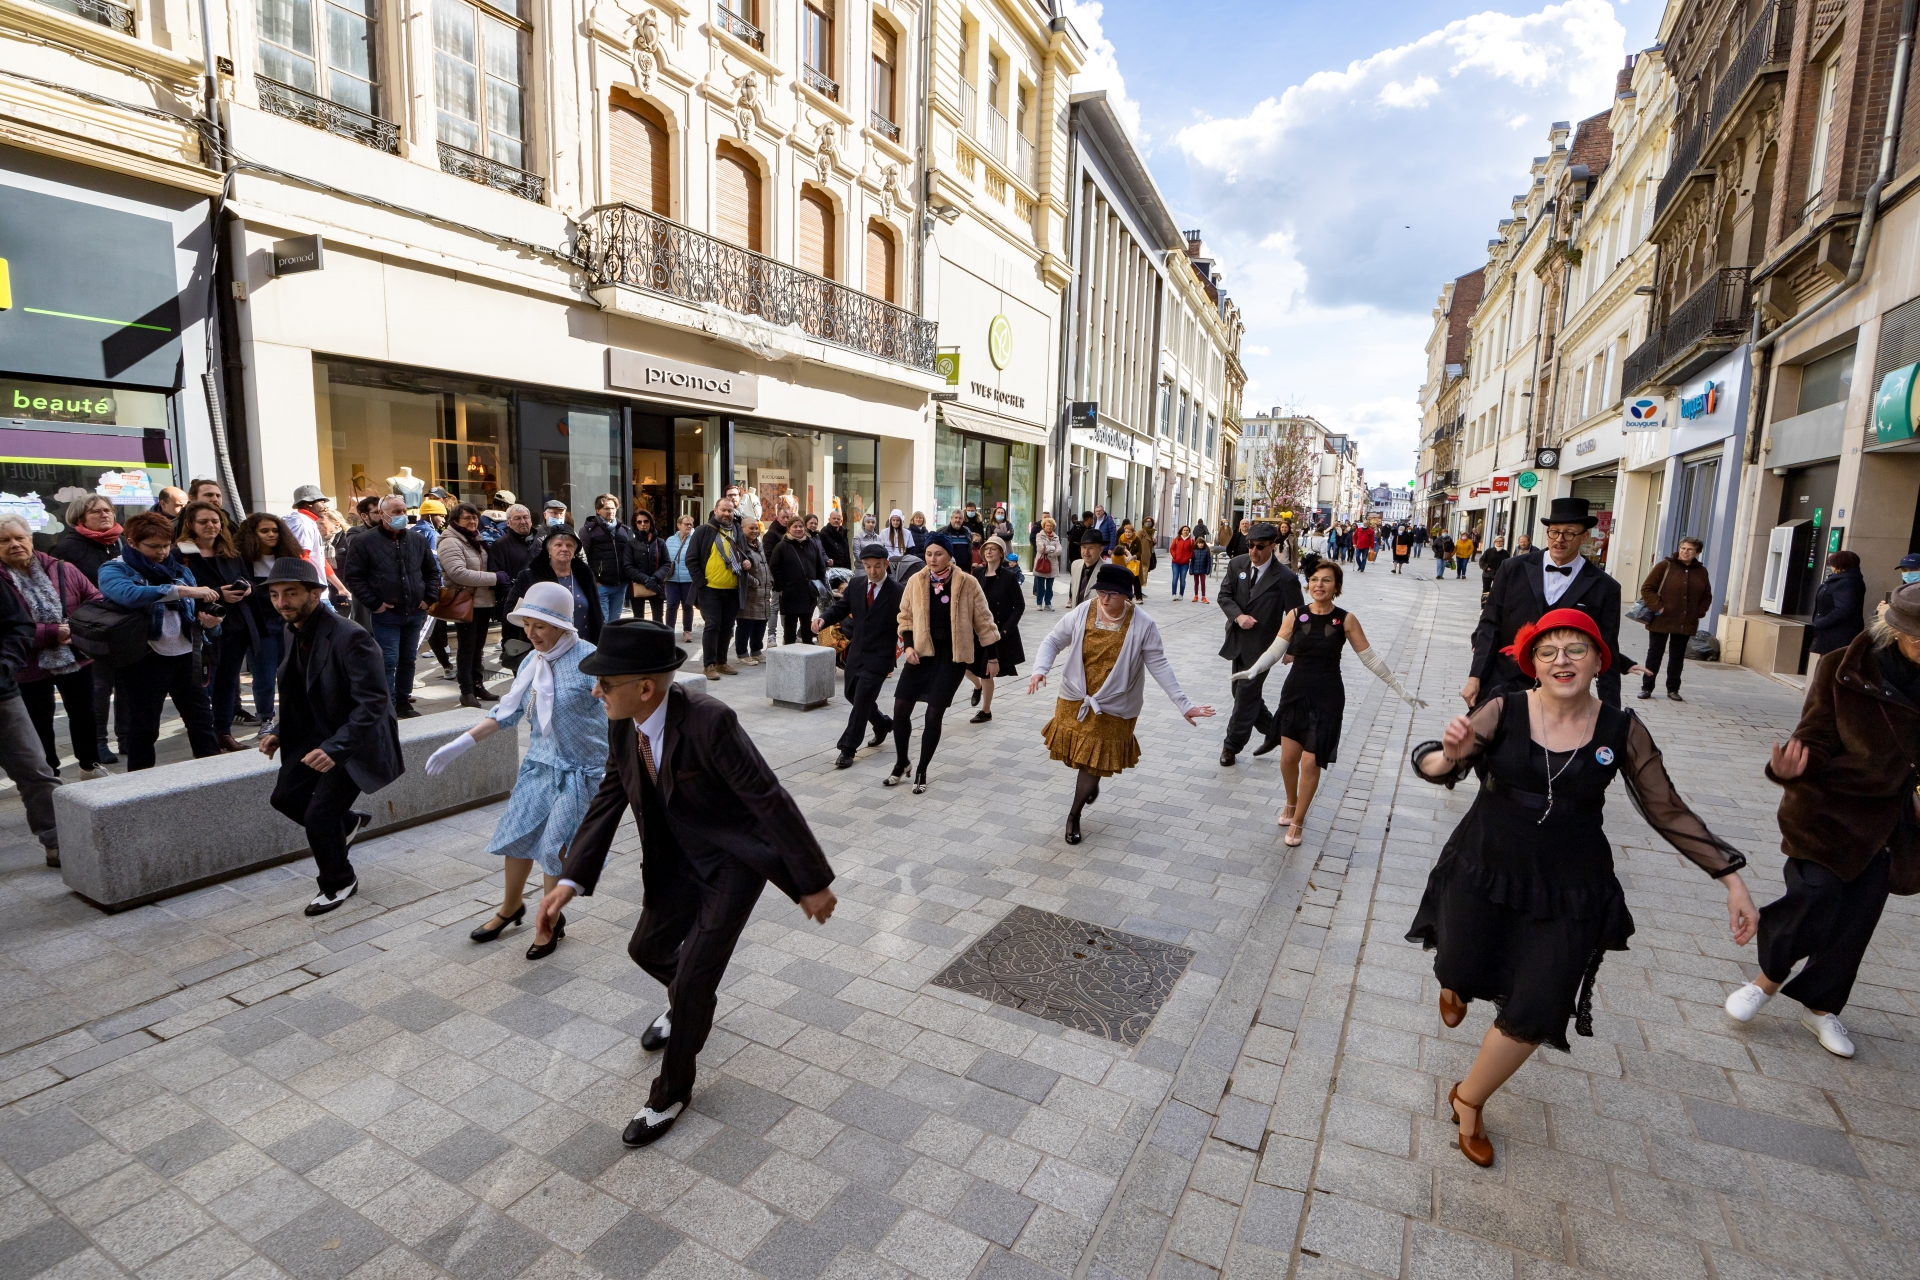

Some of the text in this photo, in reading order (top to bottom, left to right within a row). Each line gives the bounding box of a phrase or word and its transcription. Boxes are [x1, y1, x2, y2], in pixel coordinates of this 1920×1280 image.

[278, 251, 314, 268] promod
[645, 367, 733, 395] promod
[13, 389, 109, 415] beauté
[970, 380, 1025, 409] YVES ROCHER
[1625, 420, 1659, 428] bouygues
